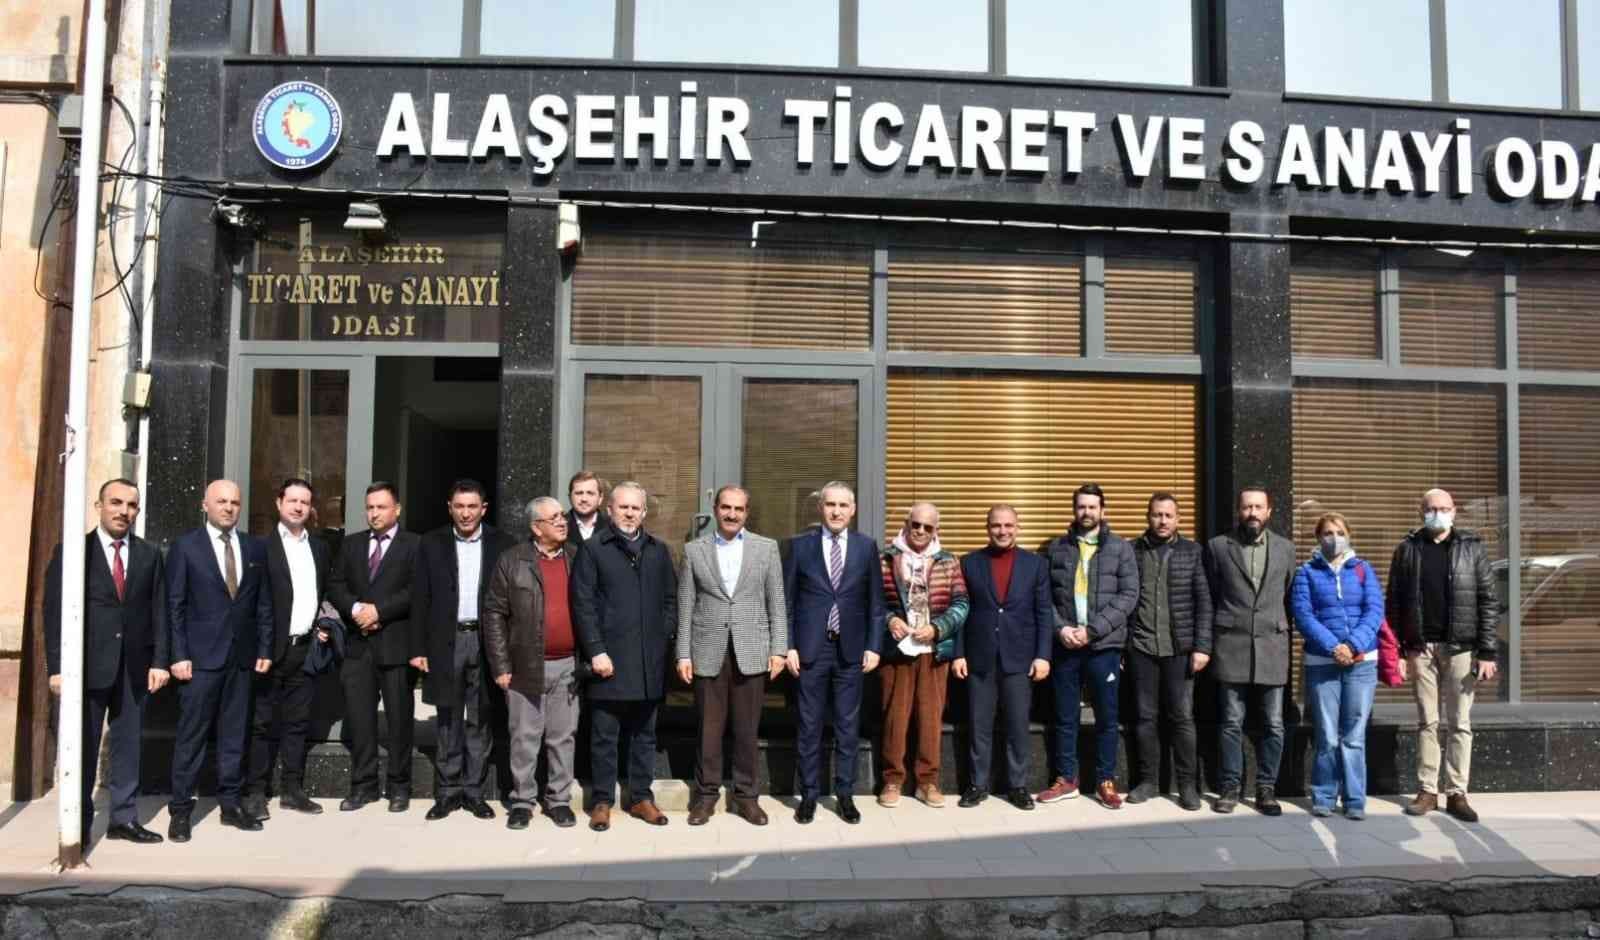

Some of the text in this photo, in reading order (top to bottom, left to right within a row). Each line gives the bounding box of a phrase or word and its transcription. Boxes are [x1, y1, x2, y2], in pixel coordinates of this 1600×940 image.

[376, 81, 752, 175] ALAŞEHİR
[784, 86, 1096, 174] TİCARET
[1117, 115, 1206, 179] VE
[1227, 118, 1472, 194] SANAYİ
[248, 243, 500, 306] ALAŞEHİR TİCARET ve SANAYİ
